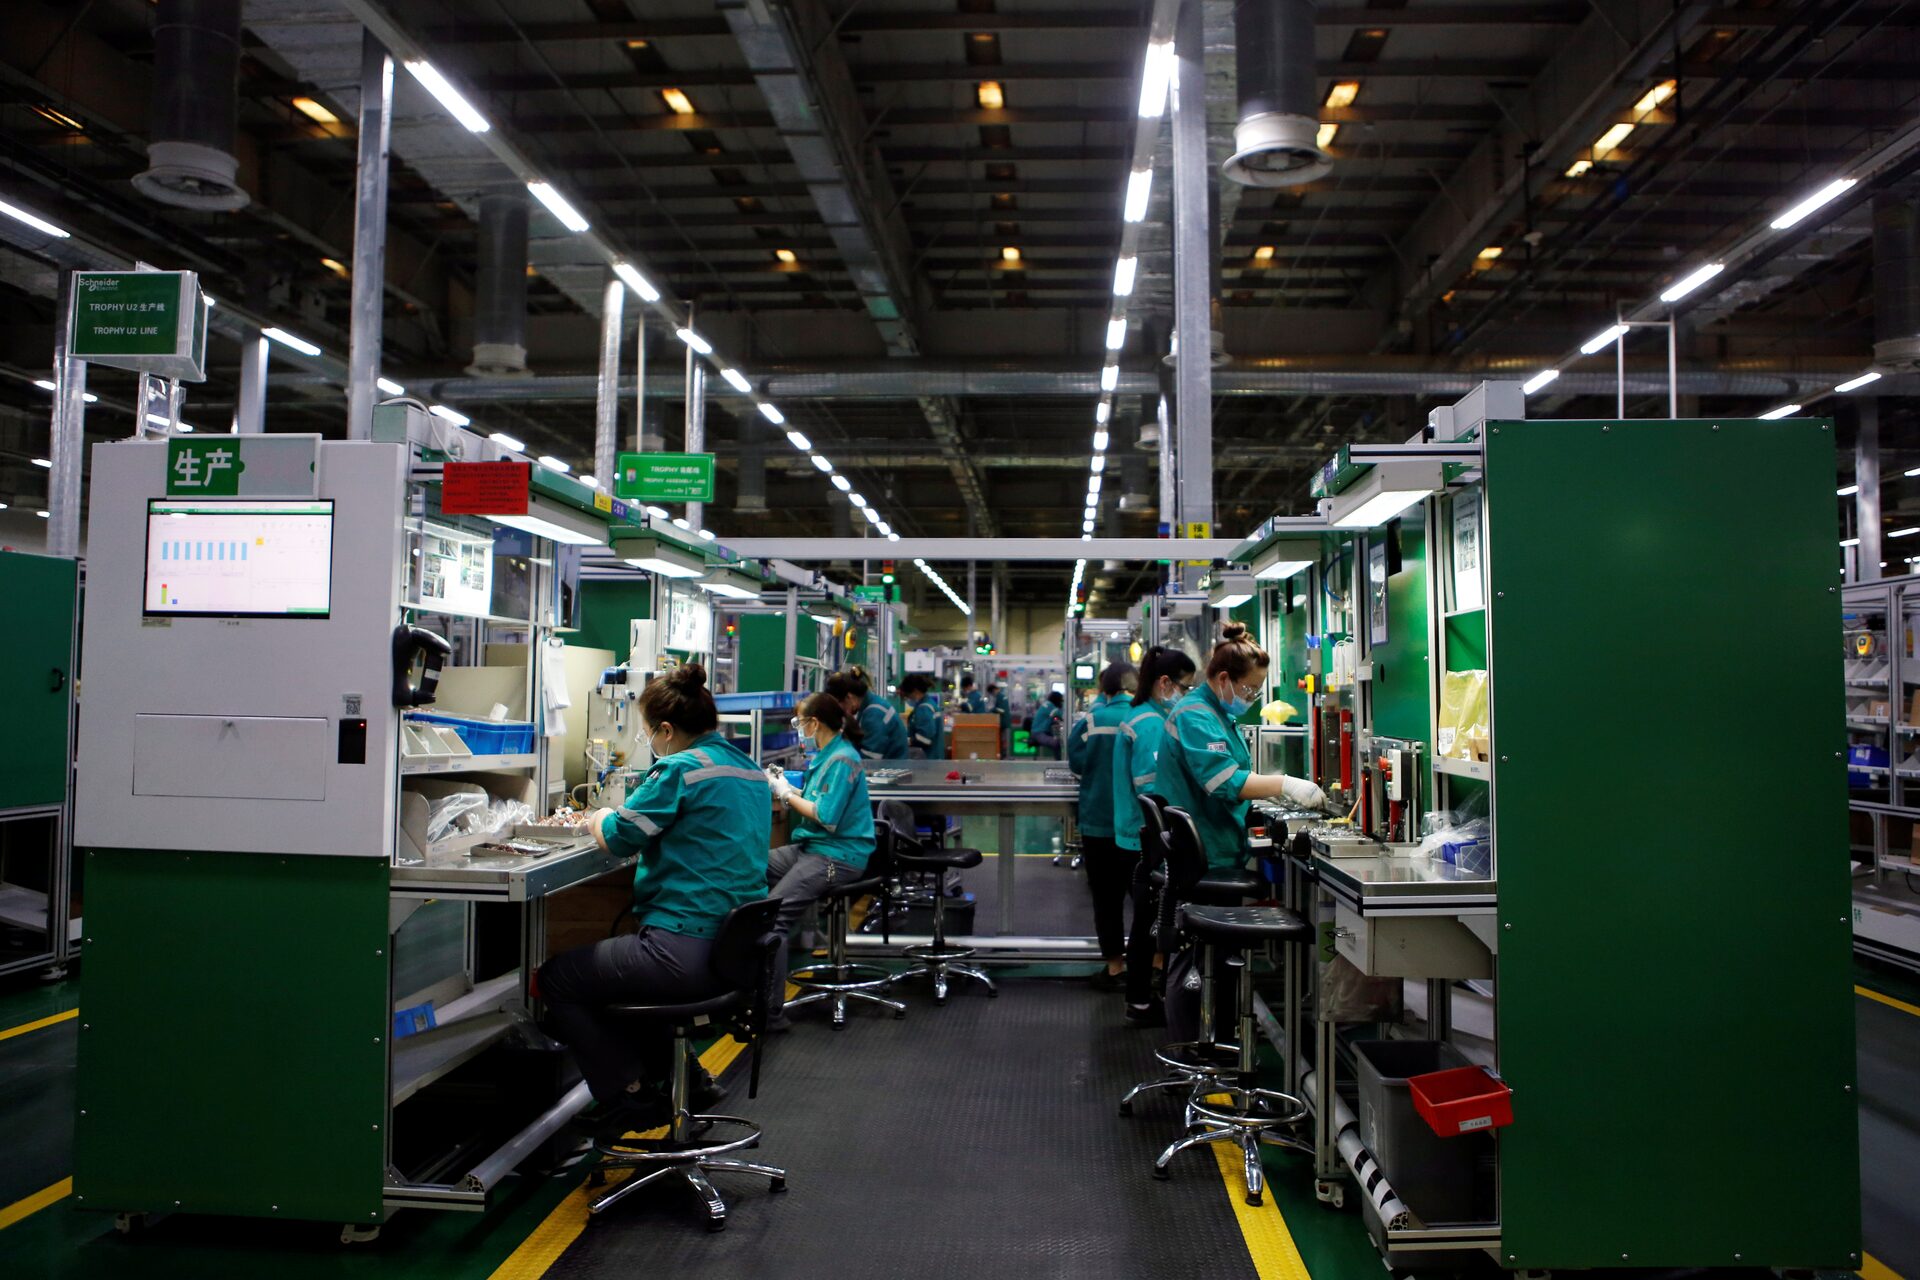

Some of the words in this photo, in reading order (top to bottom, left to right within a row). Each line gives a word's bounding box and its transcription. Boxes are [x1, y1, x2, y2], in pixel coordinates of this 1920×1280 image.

[79, 278, 120, 287] Schneider
[89, 303, 125, 312] TROPHY
[126, 303, 138, 312] U2
[139, 303, 165, 312] 生产线
[93, 326, 125, 335] TROPHY
[126, 326, 137, 335] U2
[140, 326, 158, 335] LINE
[174, 448, 233, 487] 生产
